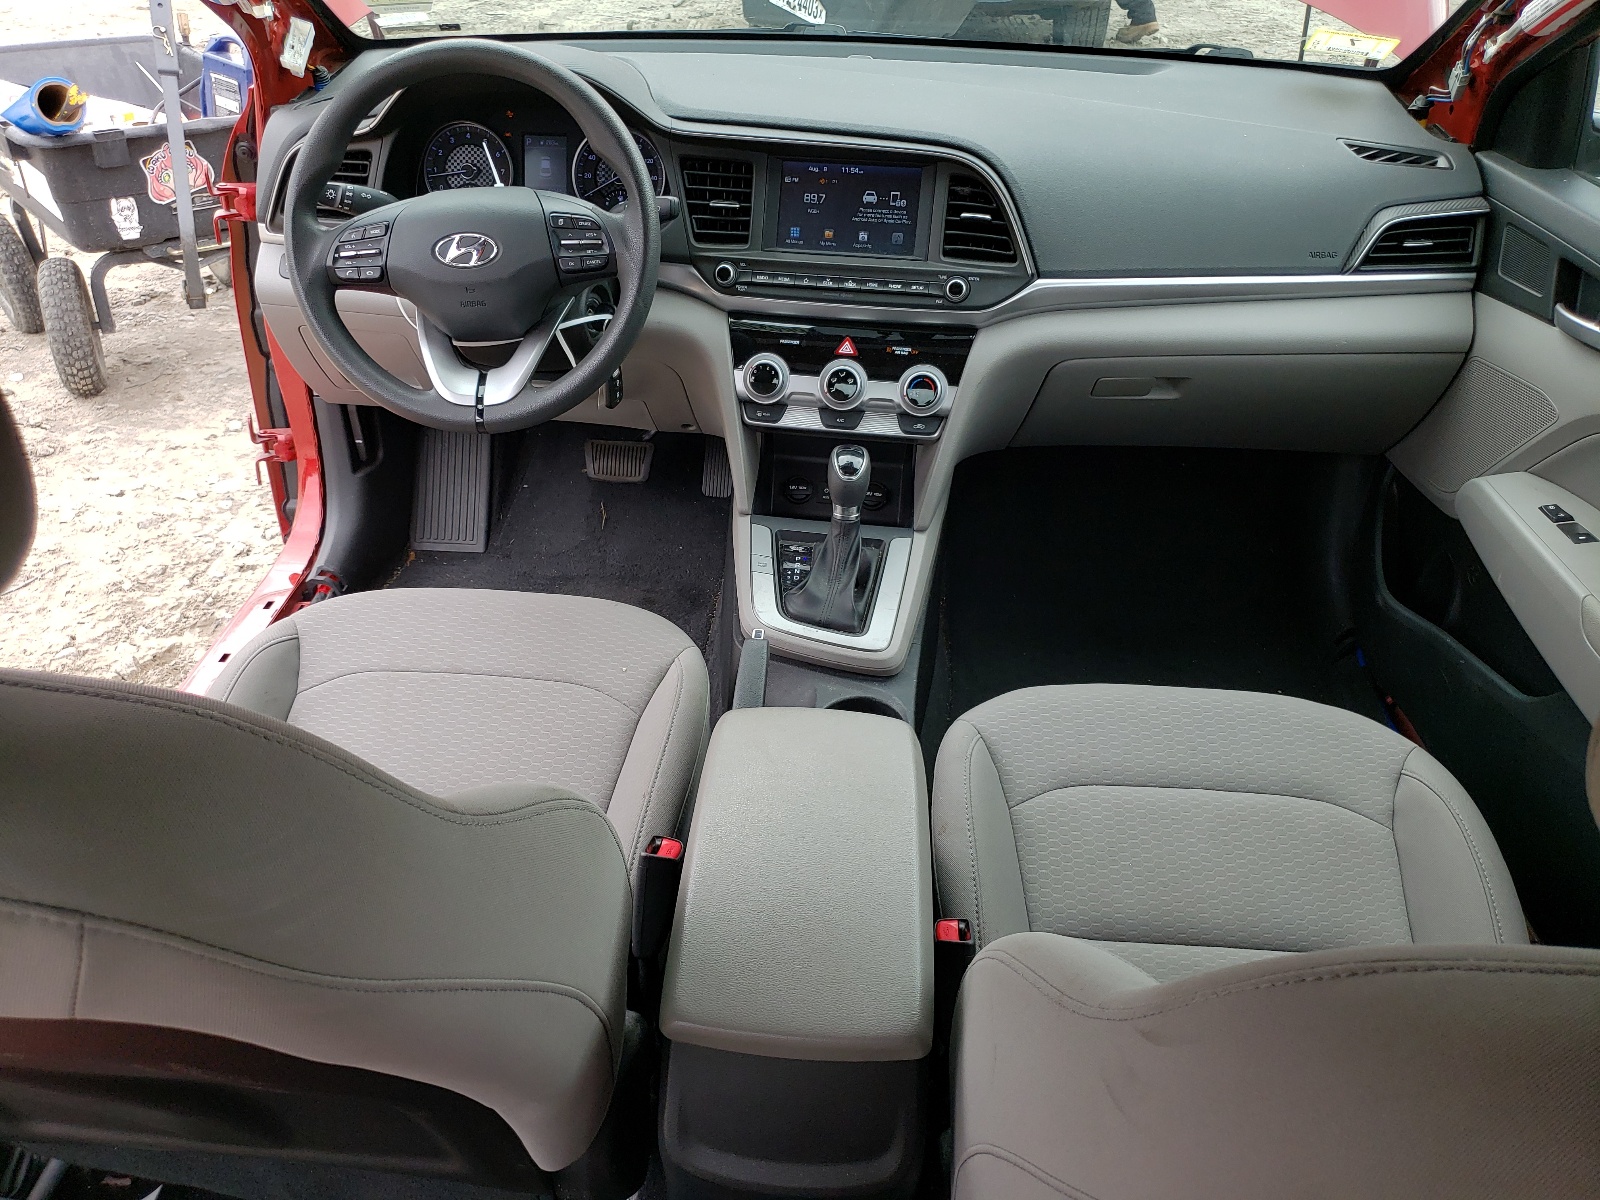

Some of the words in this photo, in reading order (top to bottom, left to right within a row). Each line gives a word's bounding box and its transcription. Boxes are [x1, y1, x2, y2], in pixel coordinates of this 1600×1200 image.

[803, 193, 826, 204] 89.7
[1308, 251, 1338, 260] AIRBAG
[460, 300, 487, 308] AIRBAG
